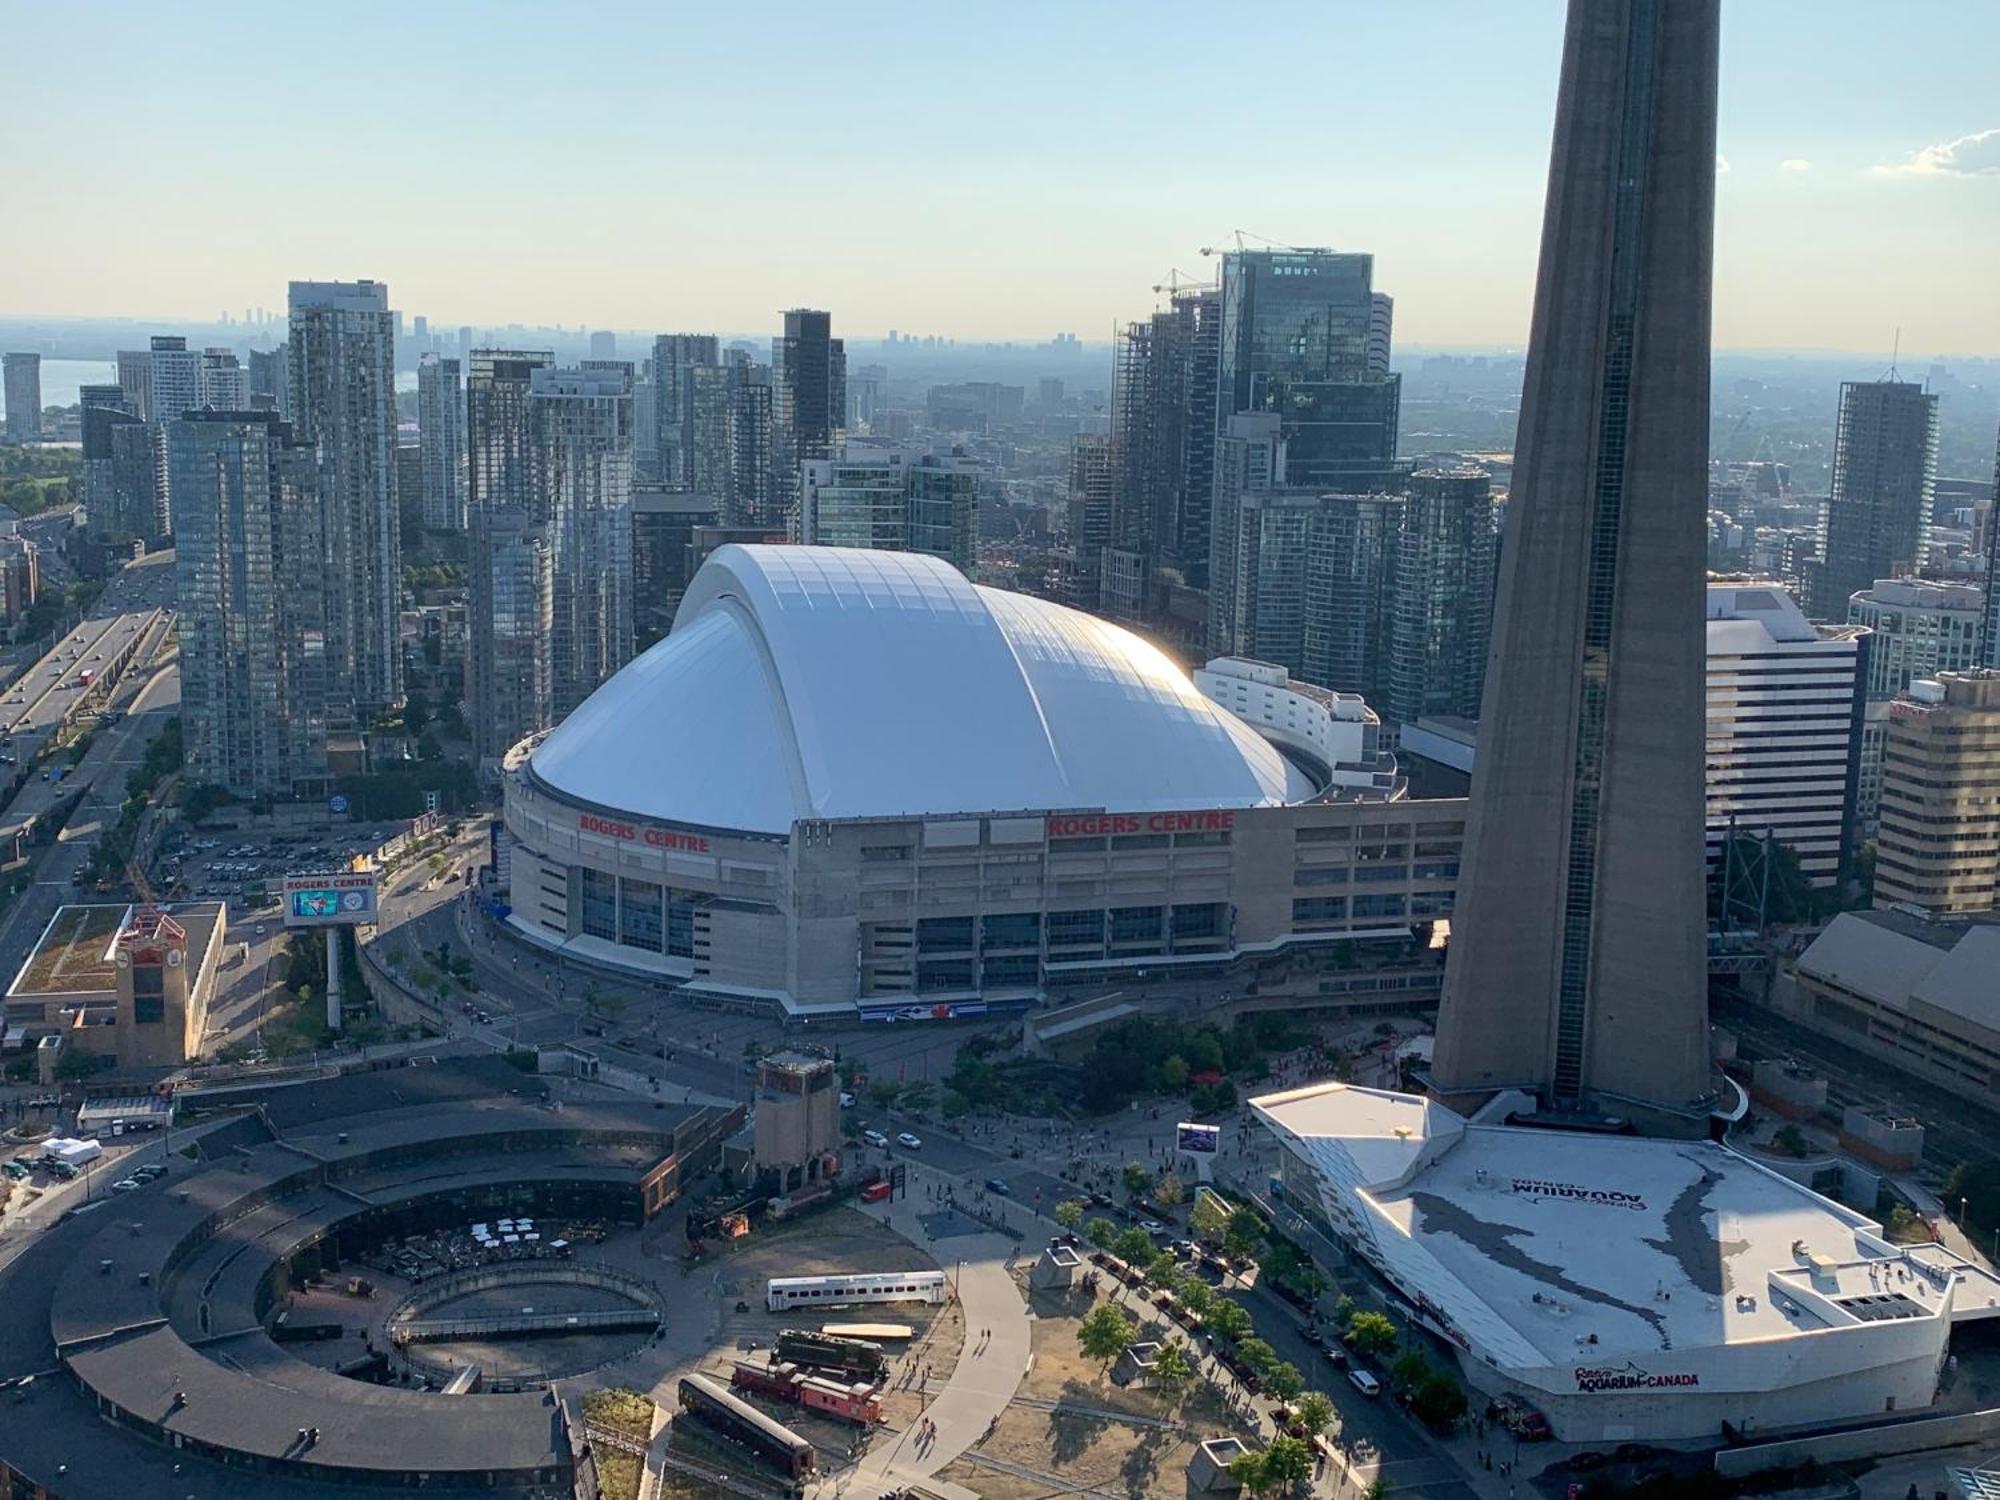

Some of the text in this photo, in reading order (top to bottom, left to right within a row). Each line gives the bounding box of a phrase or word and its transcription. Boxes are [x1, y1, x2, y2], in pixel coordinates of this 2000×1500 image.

[579, 814, 711, 853] ROGERS CENTRE
[1048, 811, 1235, 836] ROGERS CENTRE
[287, 878, 374, 889] ROGERS CENTRE
[1511, 1183, 1642, 1203] AQUARIUM
[1578, 1375, 1641, 1392] AQUARIUM
[1647, 1374, 1699, 1388] CANADA
